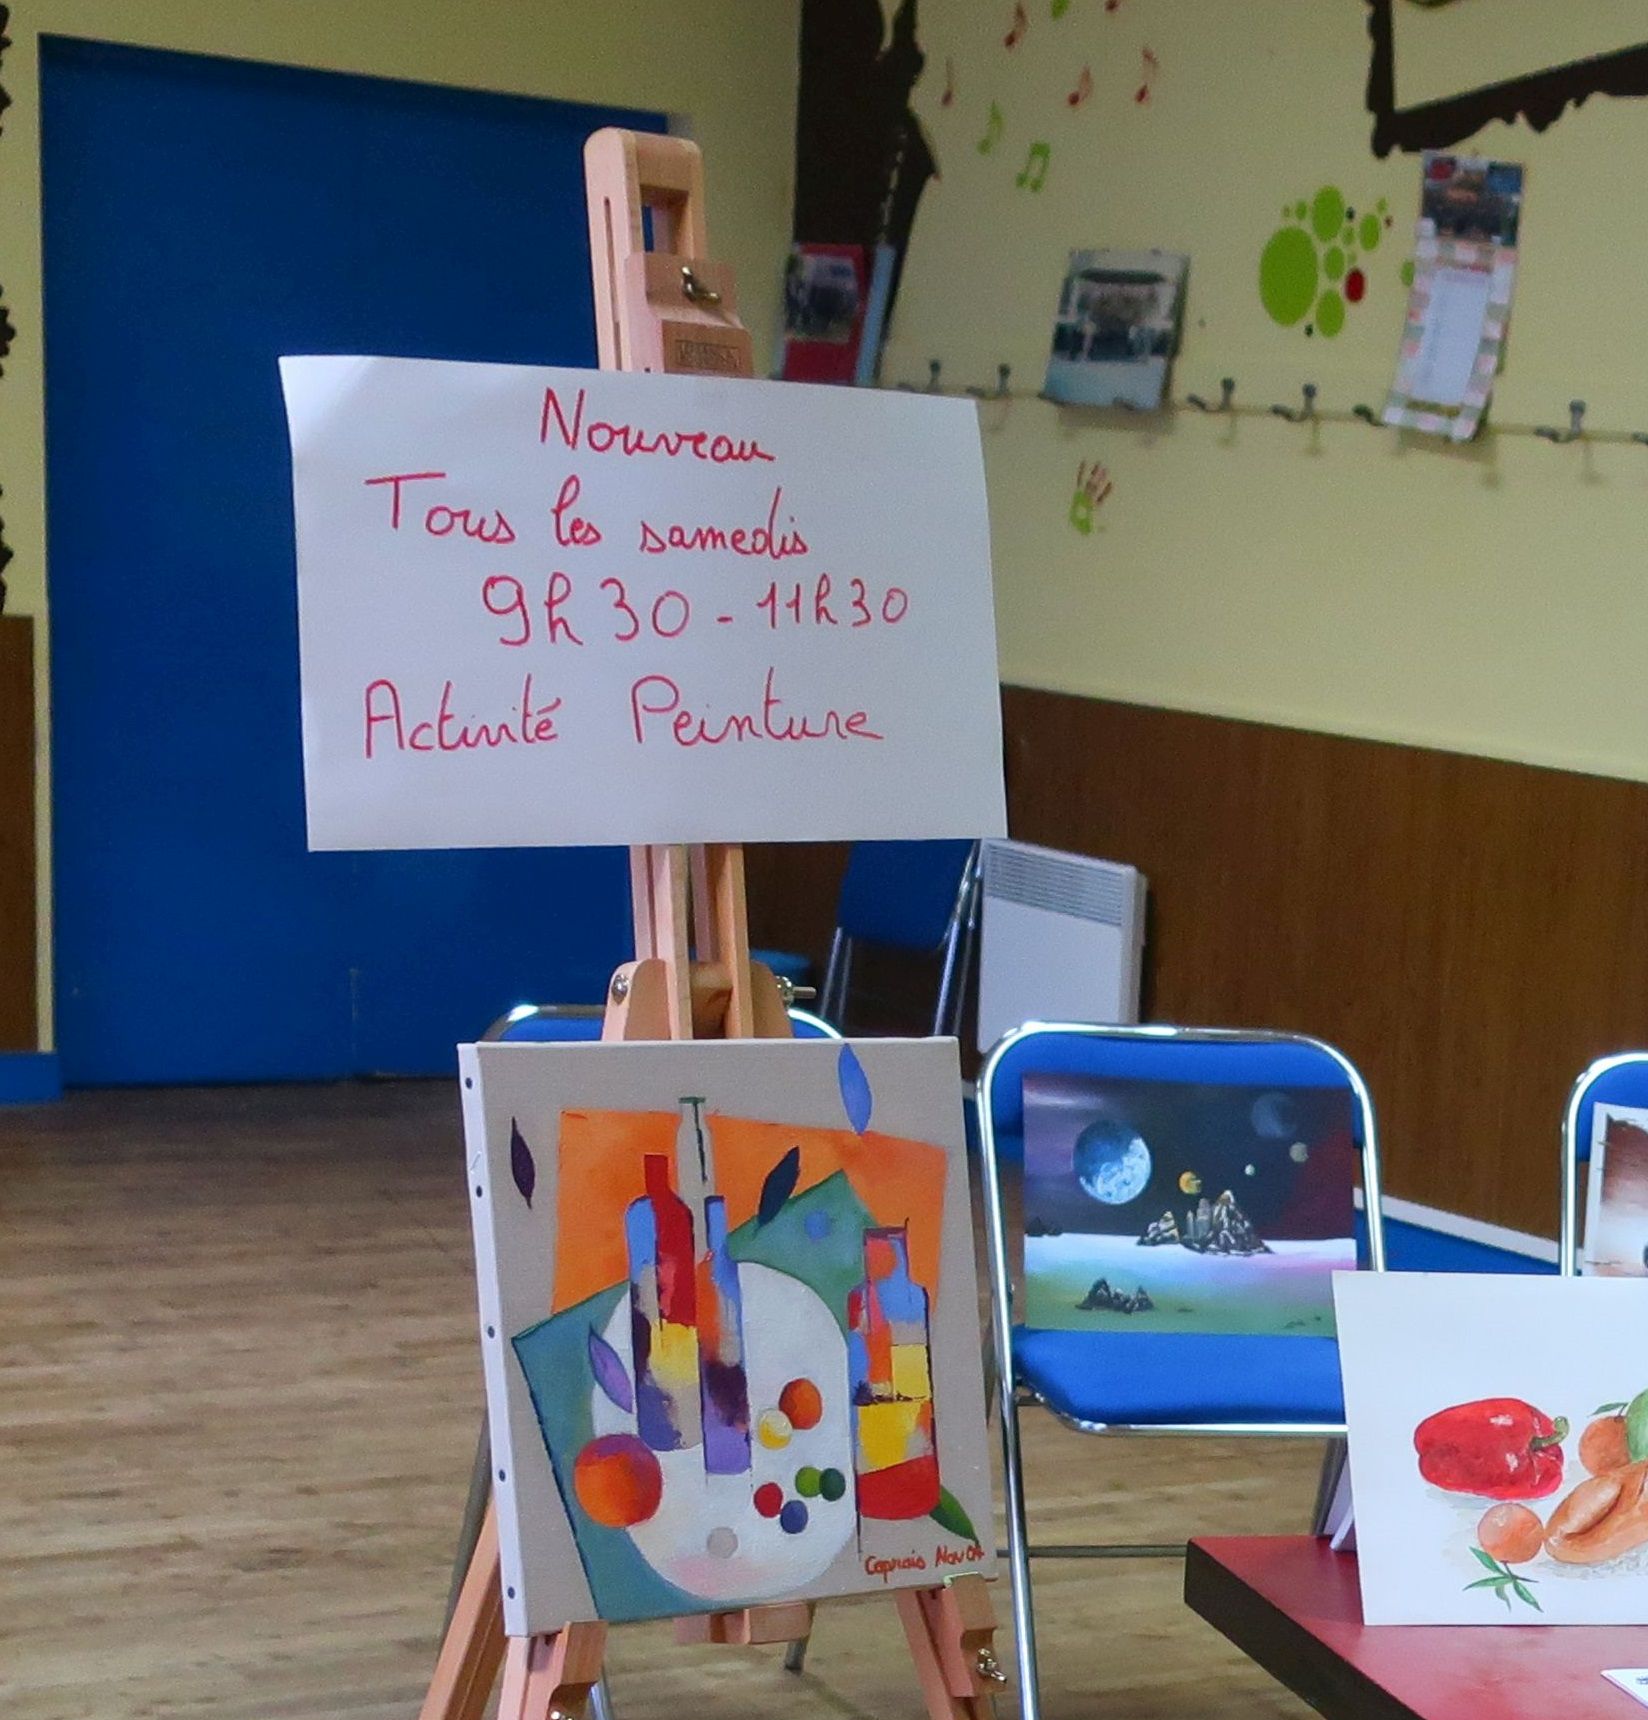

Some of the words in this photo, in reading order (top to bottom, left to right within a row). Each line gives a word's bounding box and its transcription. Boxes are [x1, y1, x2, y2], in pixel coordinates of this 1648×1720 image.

[540, 387, 776, 465] Nouveau
[365, 471, 517, 546] Tous
[550, 474, 603, 548] les
[639, 487, 811, 561] samedis
[755, 573, 908, 629] 11h30
[364, 673, 562, 759] Activité
[630, 666, 886, 747] Peinture
